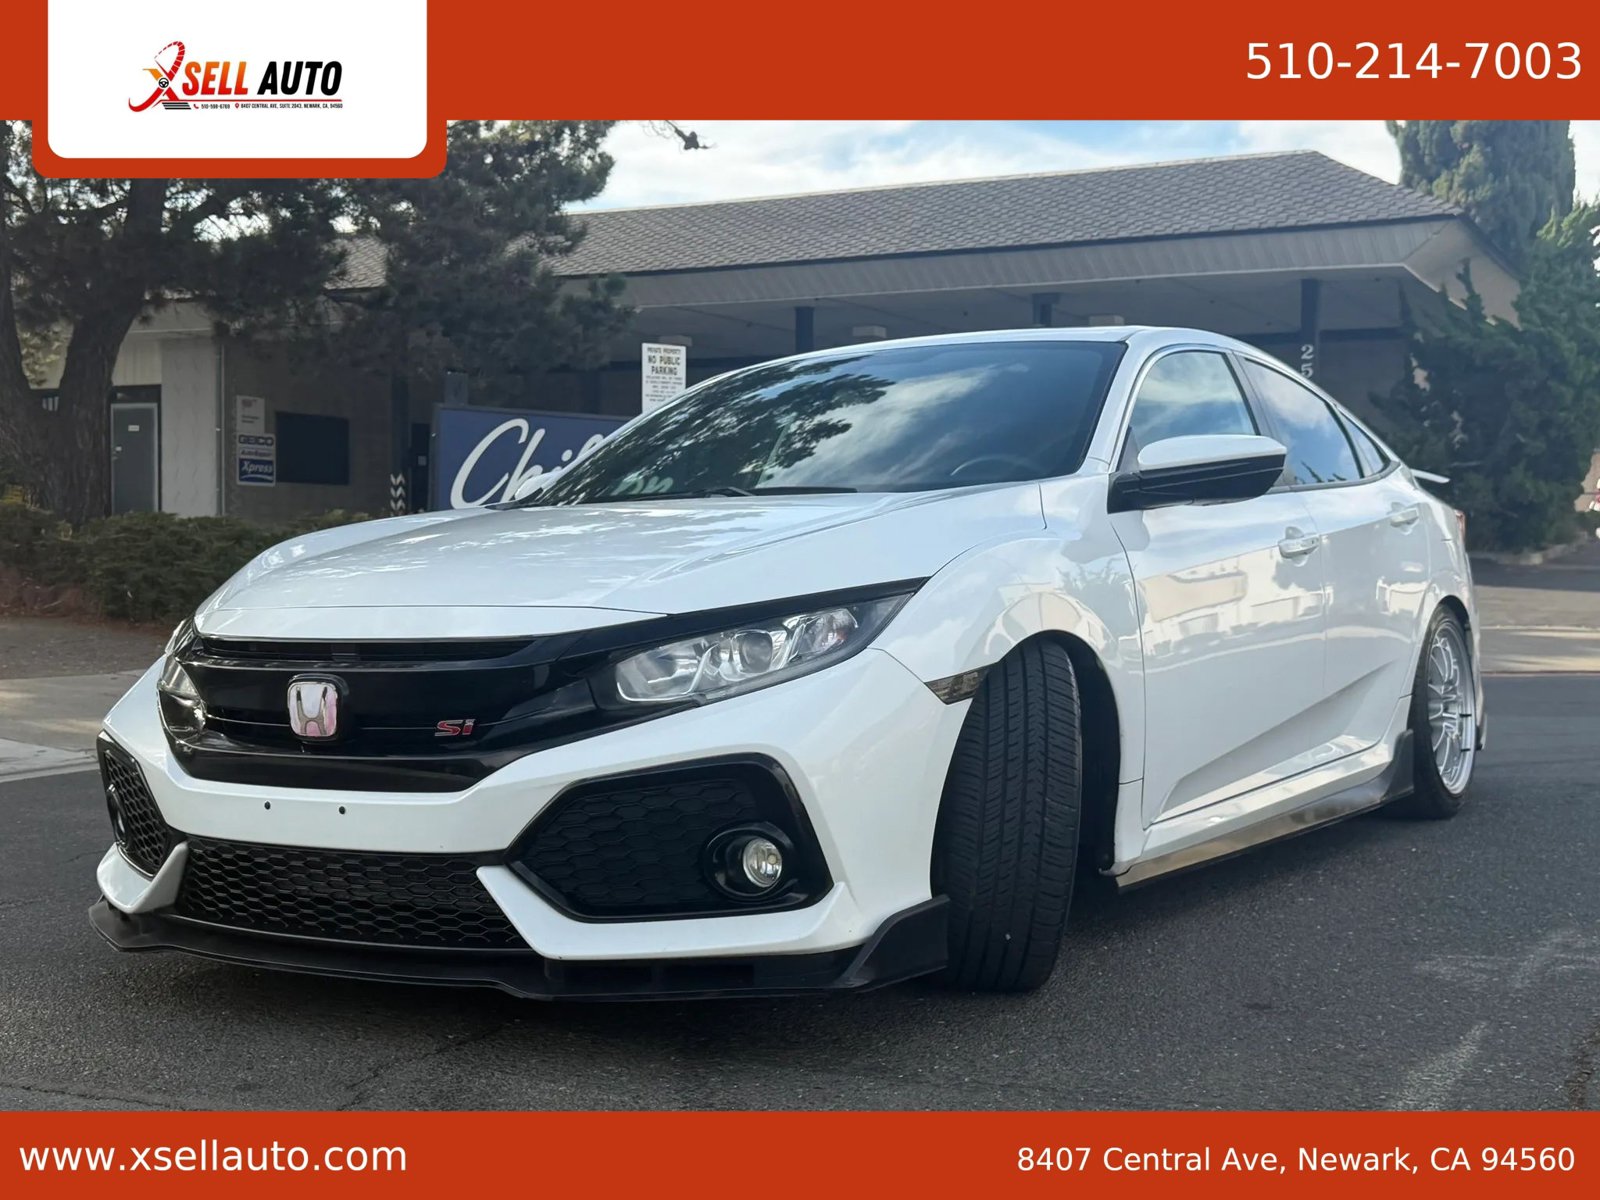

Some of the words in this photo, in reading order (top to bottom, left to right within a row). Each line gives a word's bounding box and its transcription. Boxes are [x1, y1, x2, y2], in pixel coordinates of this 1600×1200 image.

[648, 355, 656, 364] NO
[659, 356, 681, 365] PUBLIC
[651, 365, 677, 375] PARKING
[241, 461, 273, 474] Xpress
